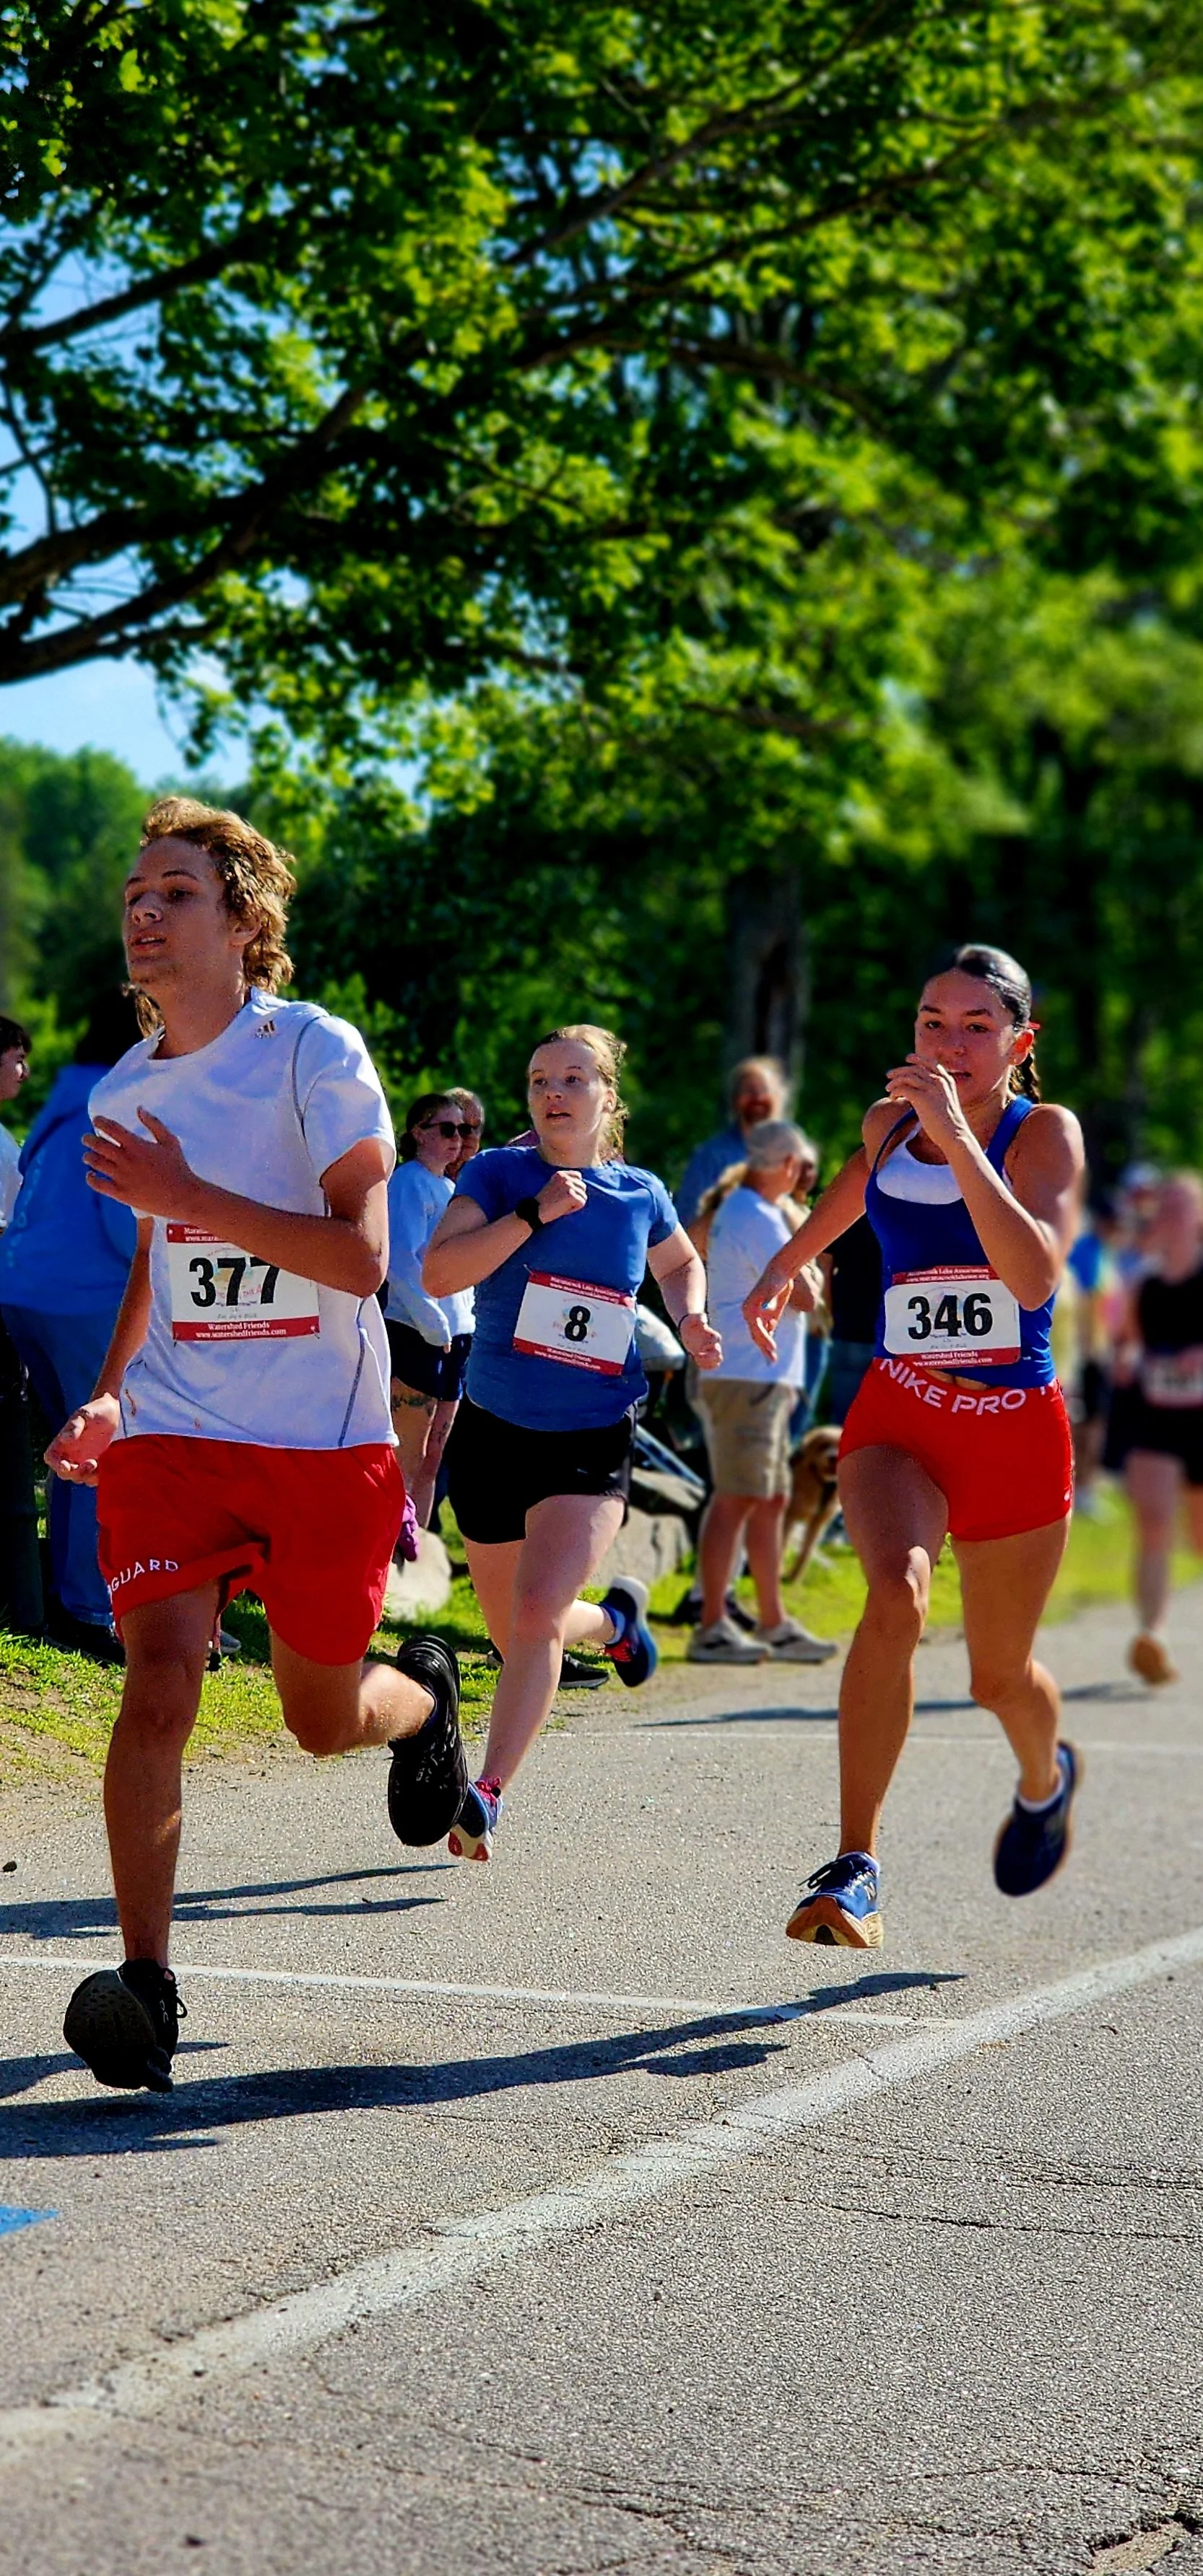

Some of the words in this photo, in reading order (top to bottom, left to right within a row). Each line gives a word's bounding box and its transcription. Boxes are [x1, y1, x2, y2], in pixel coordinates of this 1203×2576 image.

[189, 1257, 280, 1307] 377
[565, 1305, 591, 1341] 8
[908, 1292, 993, 1340] 346
[880, 1359, 947, 1408] NIKE
[952, 1388, 1027, 1416] PRO
